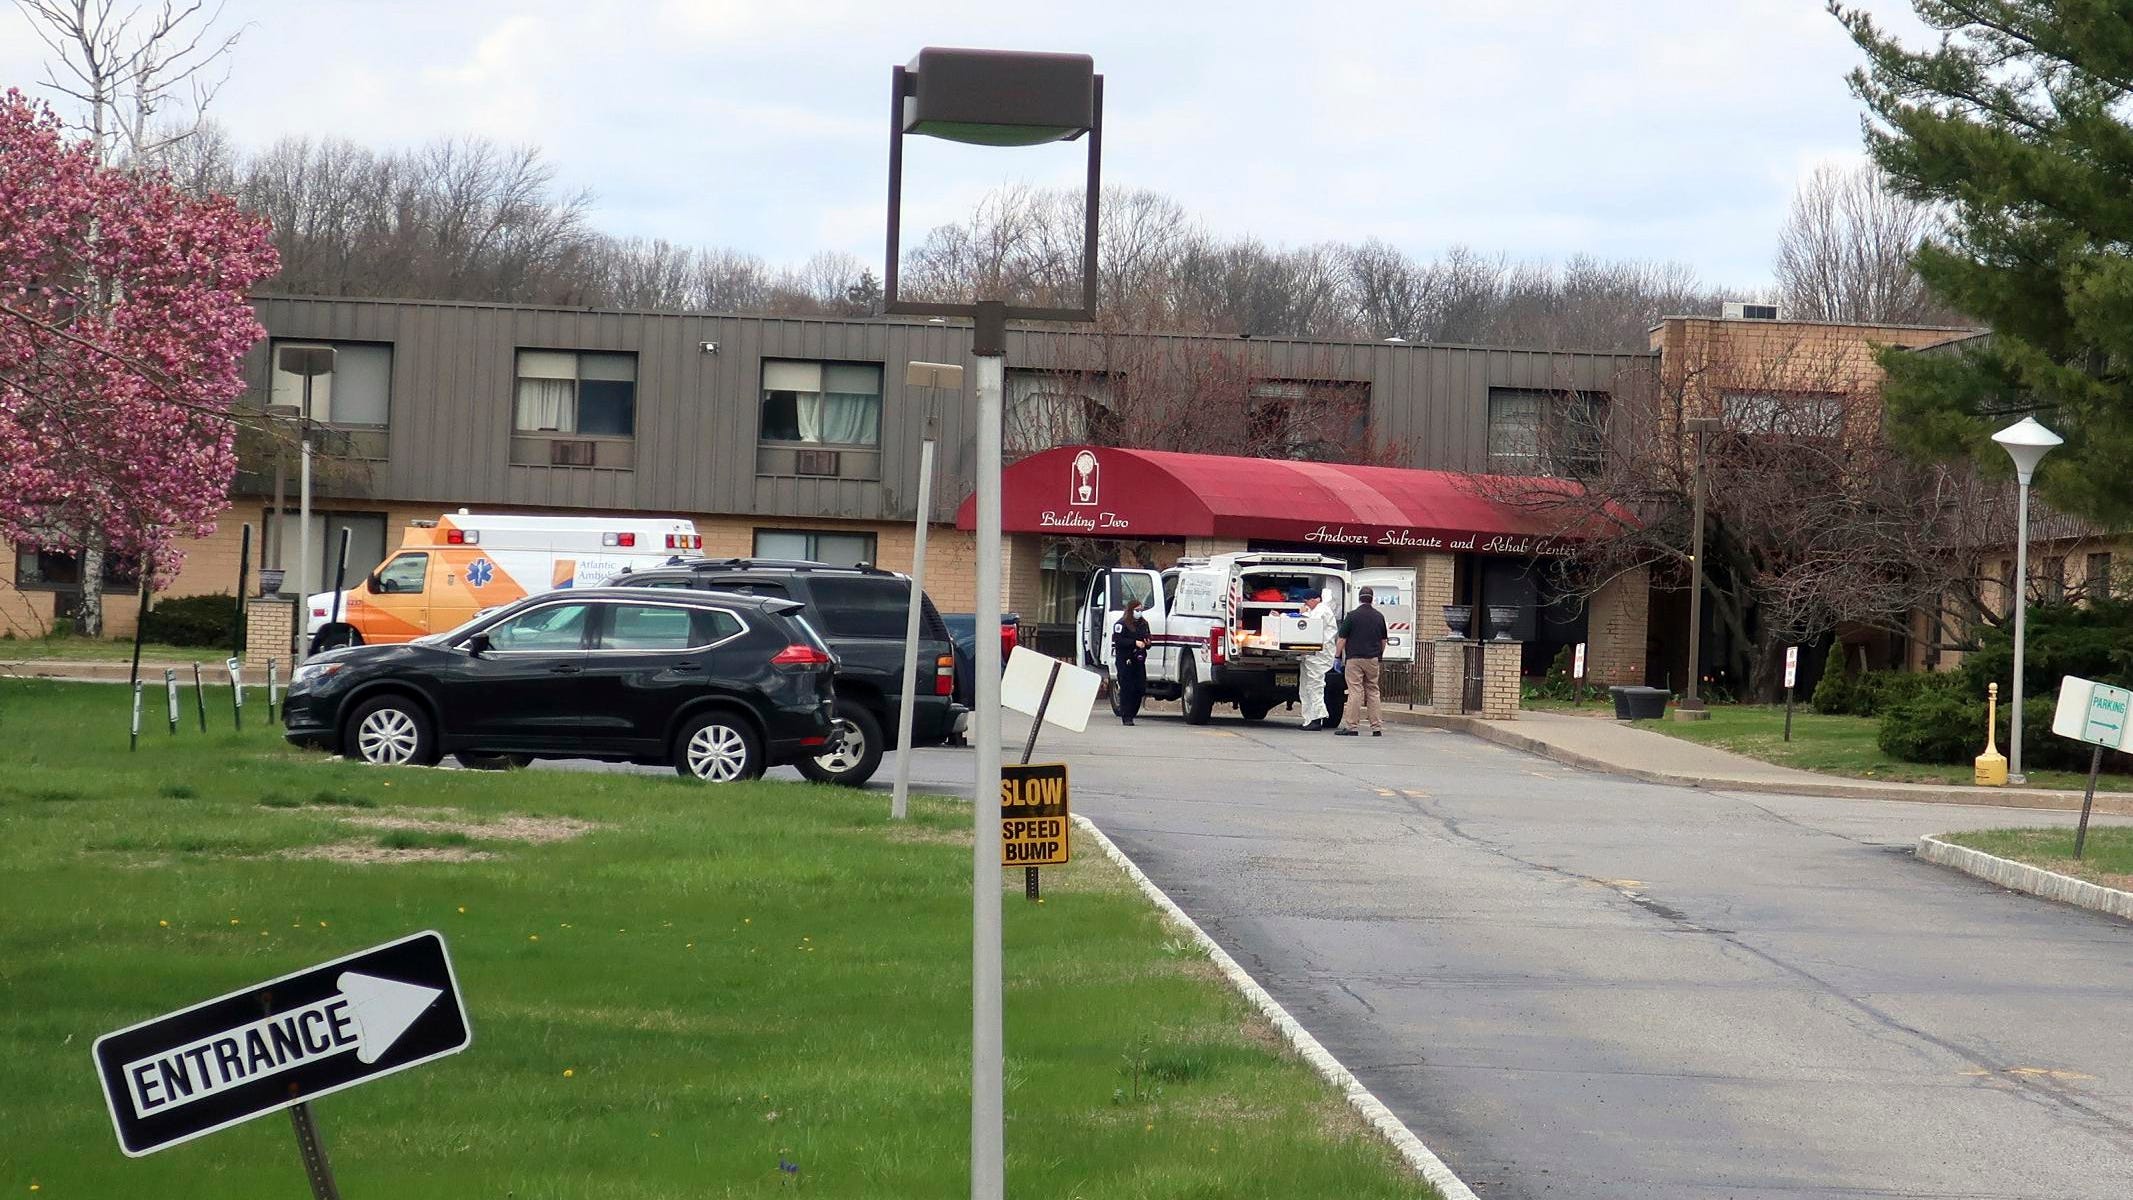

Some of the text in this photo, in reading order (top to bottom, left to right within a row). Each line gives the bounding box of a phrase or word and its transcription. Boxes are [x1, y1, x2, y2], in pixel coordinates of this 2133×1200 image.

[1040, 510, 1129, 531] Building Two
[1304, 525, 1369, 543] Andover
[1377, 529, 1442, 548] Subacute
[1450, 533, 1477, 549] and
[1482, 535, 1529, 553] Rehab
[580, 560, 617, 569] Atlantic
[2092, 696, 2126, 714] PARKING
[1001, 777, 1063, 807] SLOW
[1002, 820, 1060, 840] SPEED
[1005, 841, 1059, 861] BUMP
[131, 999, 358, 1110] ENTRANCE
